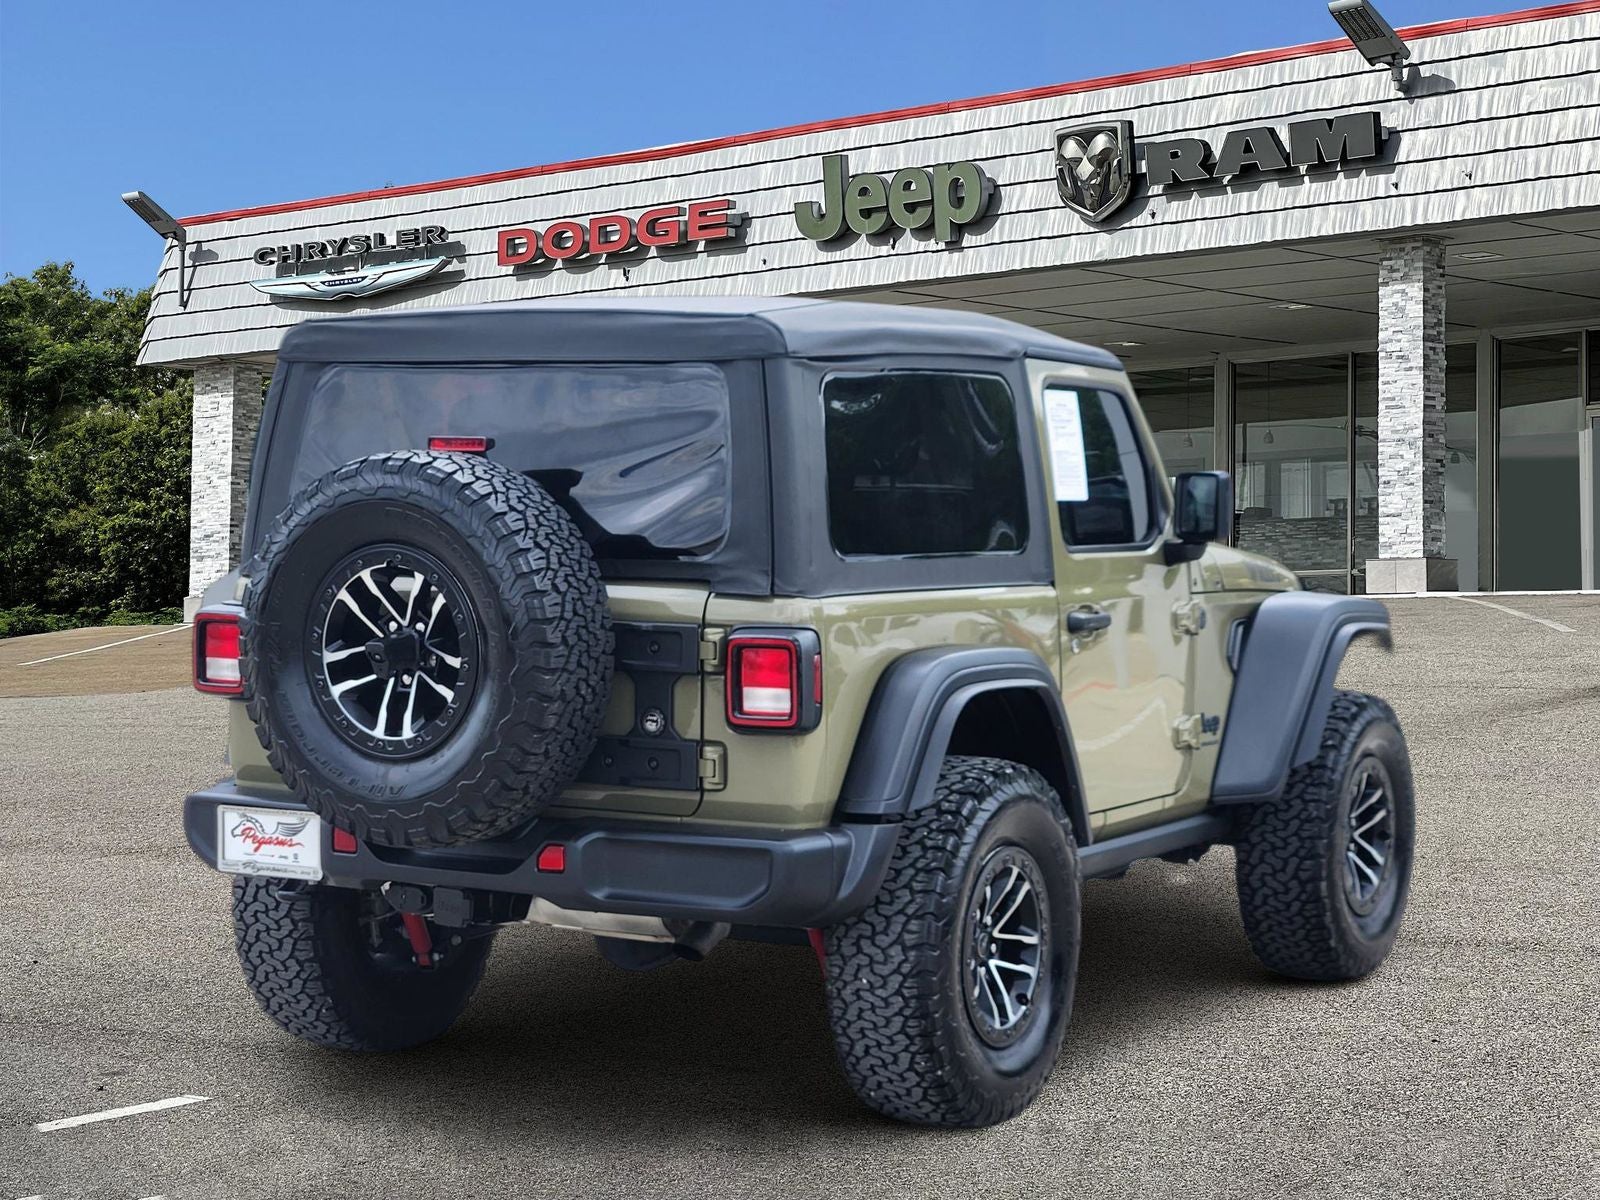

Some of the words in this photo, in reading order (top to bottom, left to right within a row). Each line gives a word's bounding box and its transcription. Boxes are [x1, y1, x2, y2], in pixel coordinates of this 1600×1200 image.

[1145, 111, 1381, 186] RAM
[794, 154, 985, 242] Jeep
[253, 225, 446, 266] CHRYSLER
[498, 200, 735, 266] DODGE
[324, 278, 363, 286] CHRYSLER
[240, 827, 305, 853] Pegasus
